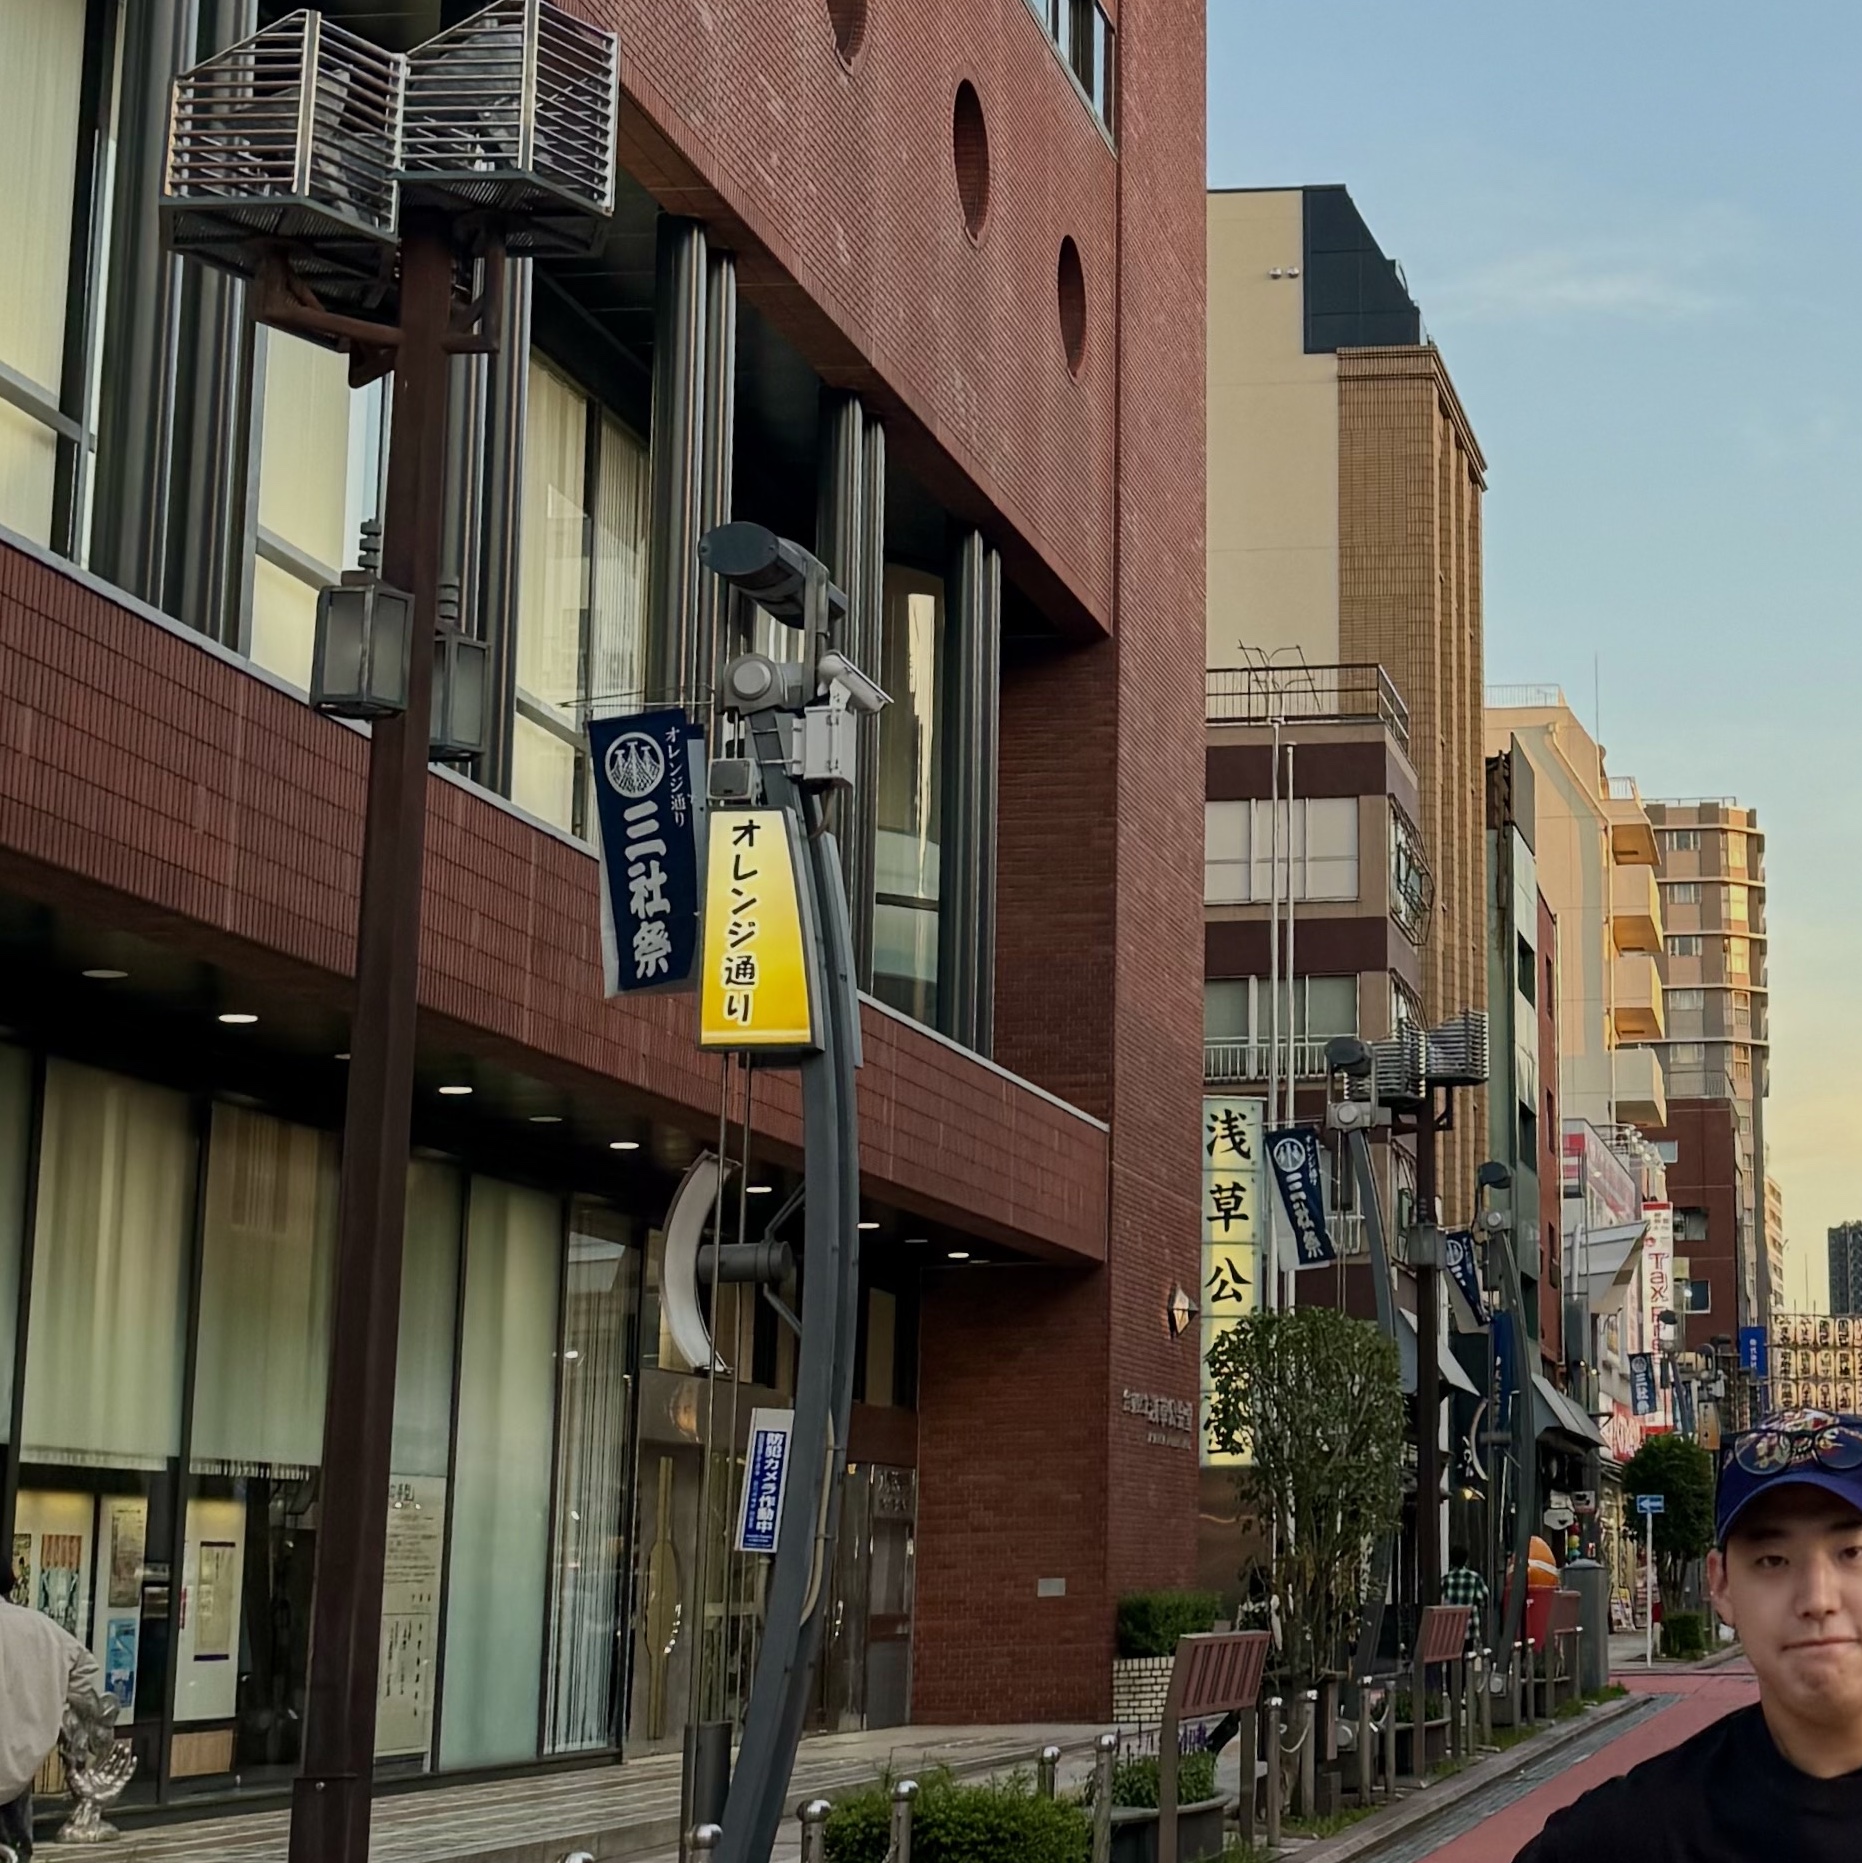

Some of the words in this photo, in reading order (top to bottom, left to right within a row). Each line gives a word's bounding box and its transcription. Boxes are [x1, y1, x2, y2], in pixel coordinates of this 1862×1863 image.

[622, 800, 673, 980] 三社祭
[723, 818, 762, 1024] オレンジ通り
[1285, 1171, 1324, 1259] 三社祭
[756, 1432, 785, 1534] 防犯カメラ作動中
